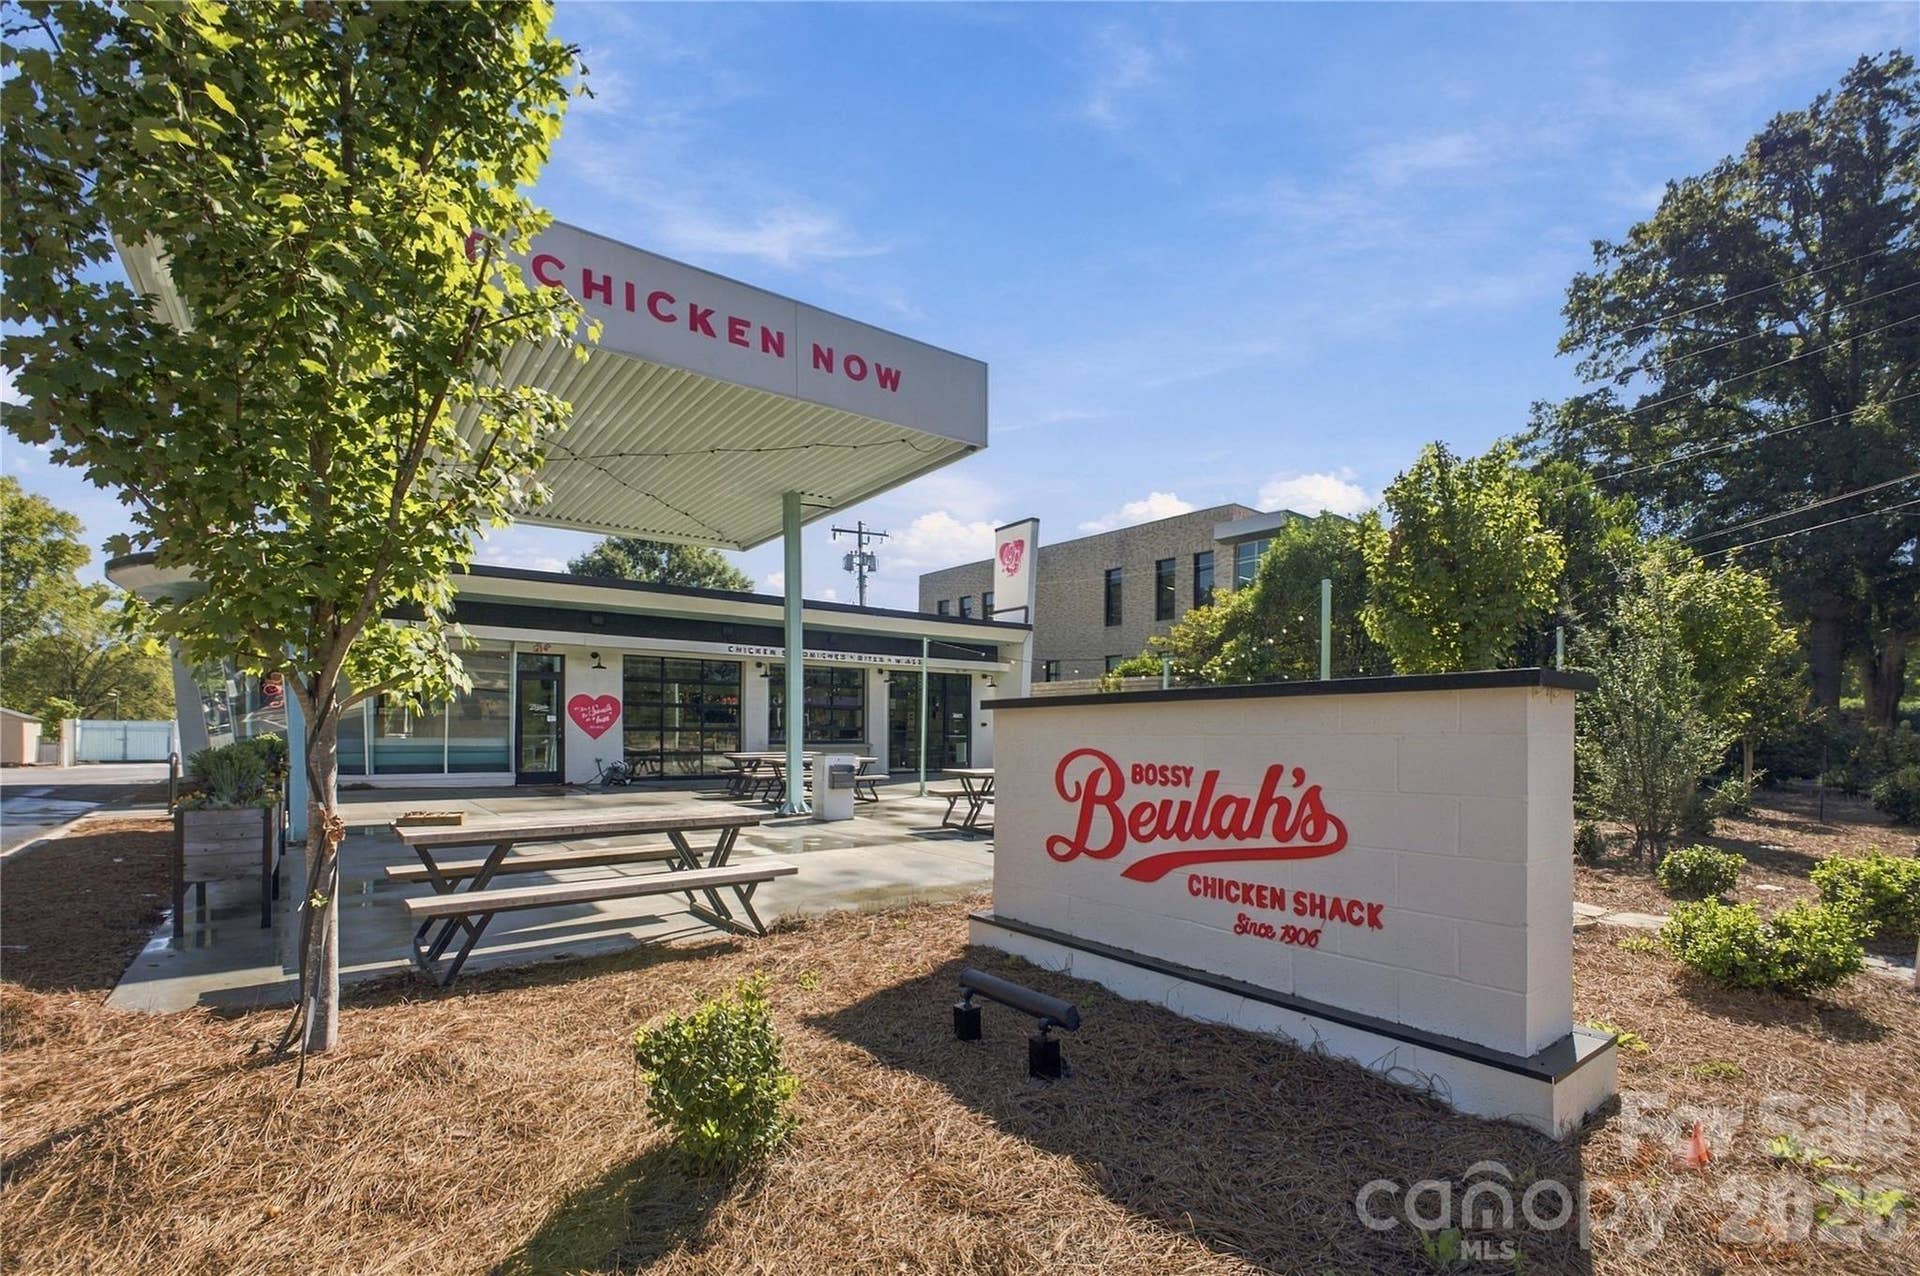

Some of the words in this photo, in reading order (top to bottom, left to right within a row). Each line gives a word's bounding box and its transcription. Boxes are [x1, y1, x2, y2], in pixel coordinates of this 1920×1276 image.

[532, 254, 785, 358] CHICKEN
[812, 343, 902, 392] NOW
[728, 646, 776, 656] CHICKEN
[1131, 763, 1194, 788] BOSSY
[1046, 748, 1348, 866] Beulah's
[1188, 874, 1286, 911] CHICKEN
[1293, 890, 1384, 930] SHACK
[1233, 913, 1276, 940] Since
[1280, 924, 1322, 949] 1906
